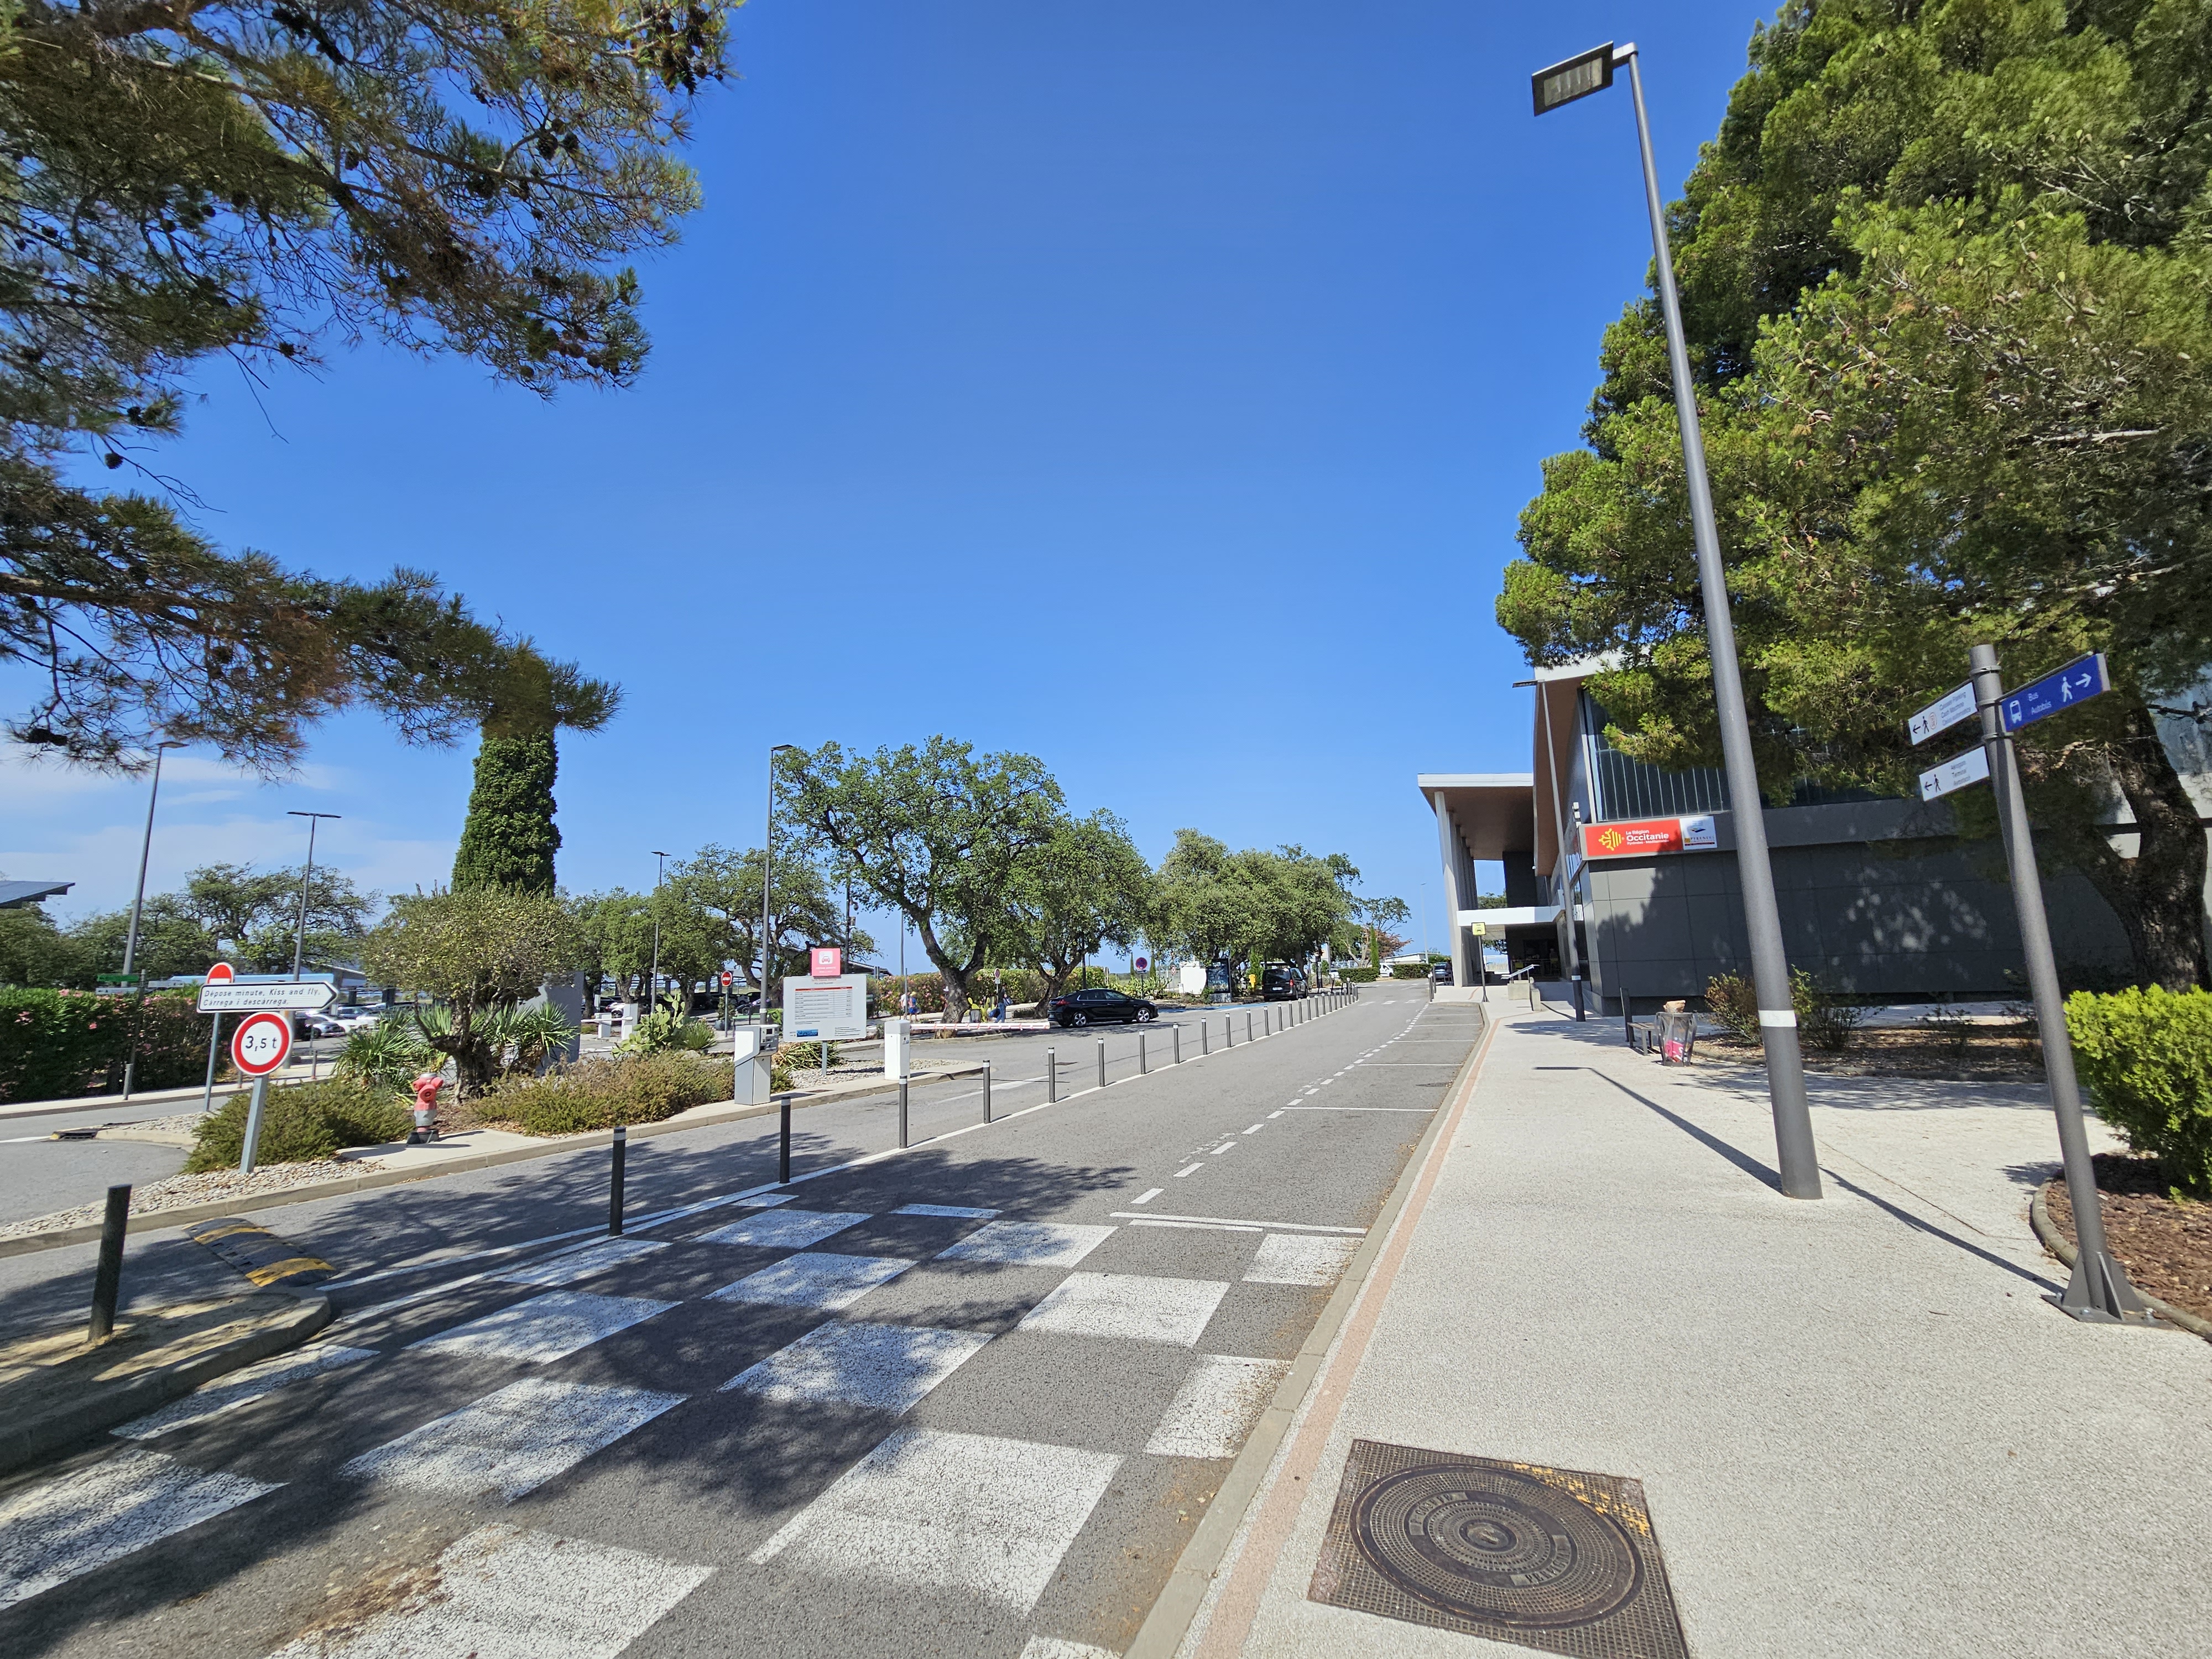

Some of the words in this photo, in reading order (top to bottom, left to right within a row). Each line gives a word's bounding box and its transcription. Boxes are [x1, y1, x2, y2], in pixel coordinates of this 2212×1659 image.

[2028, 692, 2039, 701] Bus
[1626, 832, 1669, 842] Occitanie
[245, 1036, 267, 1051] 3,5
[272, 1037, 278, 1048] t
